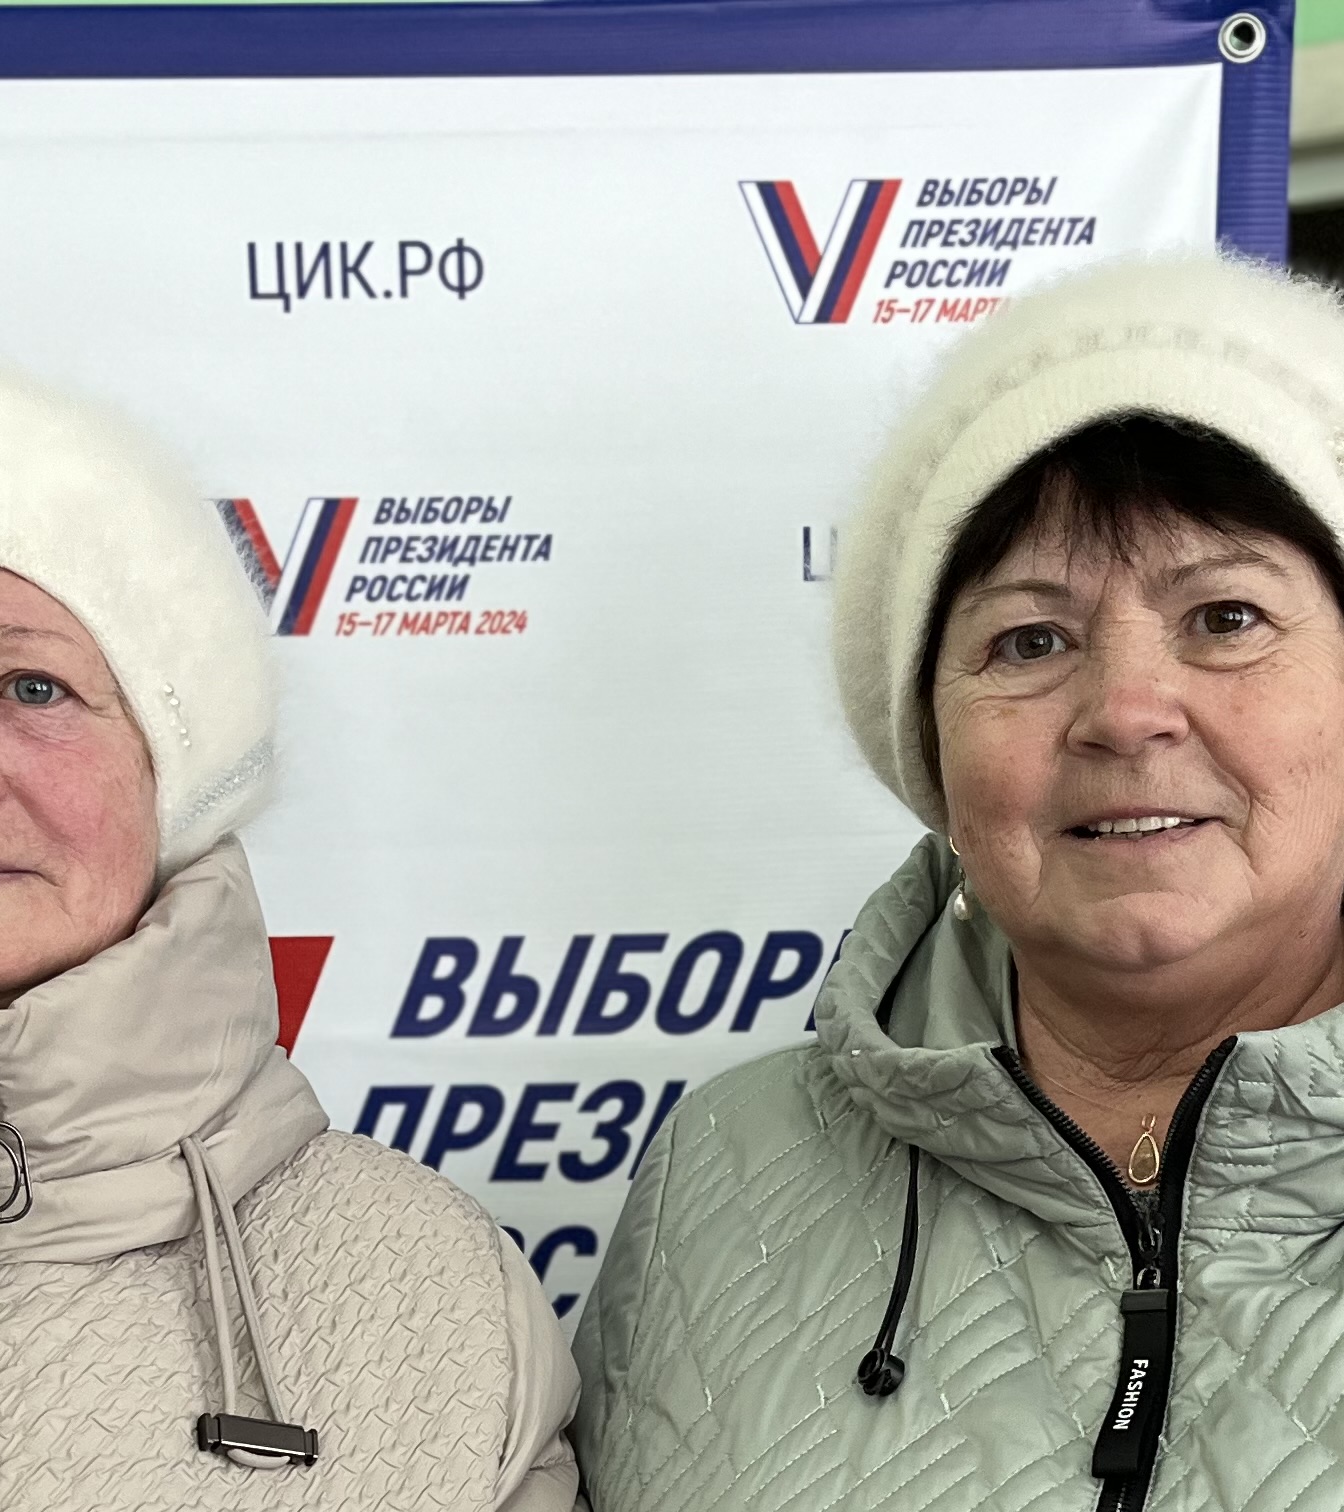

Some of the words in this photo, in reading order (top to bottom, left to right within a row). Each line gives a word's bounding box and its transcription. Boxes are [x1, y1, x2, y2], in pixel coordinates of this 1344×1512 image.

[916, 177, 1058, 207] ВЫБОРЫ
[900, 217, 1097, 251] ПРЕЗИДЕНТА
[247, 238, 484, 312] ЦИК.РФ
[884, 259, 1011, 288] РОССИИ
[935, 297, 1012, 324] МАРТ
[372, 496, 513, 525] ВЫБОРЫ
[359, 534, 553, 567] ПРЕЗИДЕНТА
[344, 574, 471, 602] РОССИИ
[396, 611, 471, 636] МАРТА
[474, 610, 528, 635] 2024
[389, 929, 853, 1038] ВЫБОР
[1112, 1358, 1149, 1430] FASHION
